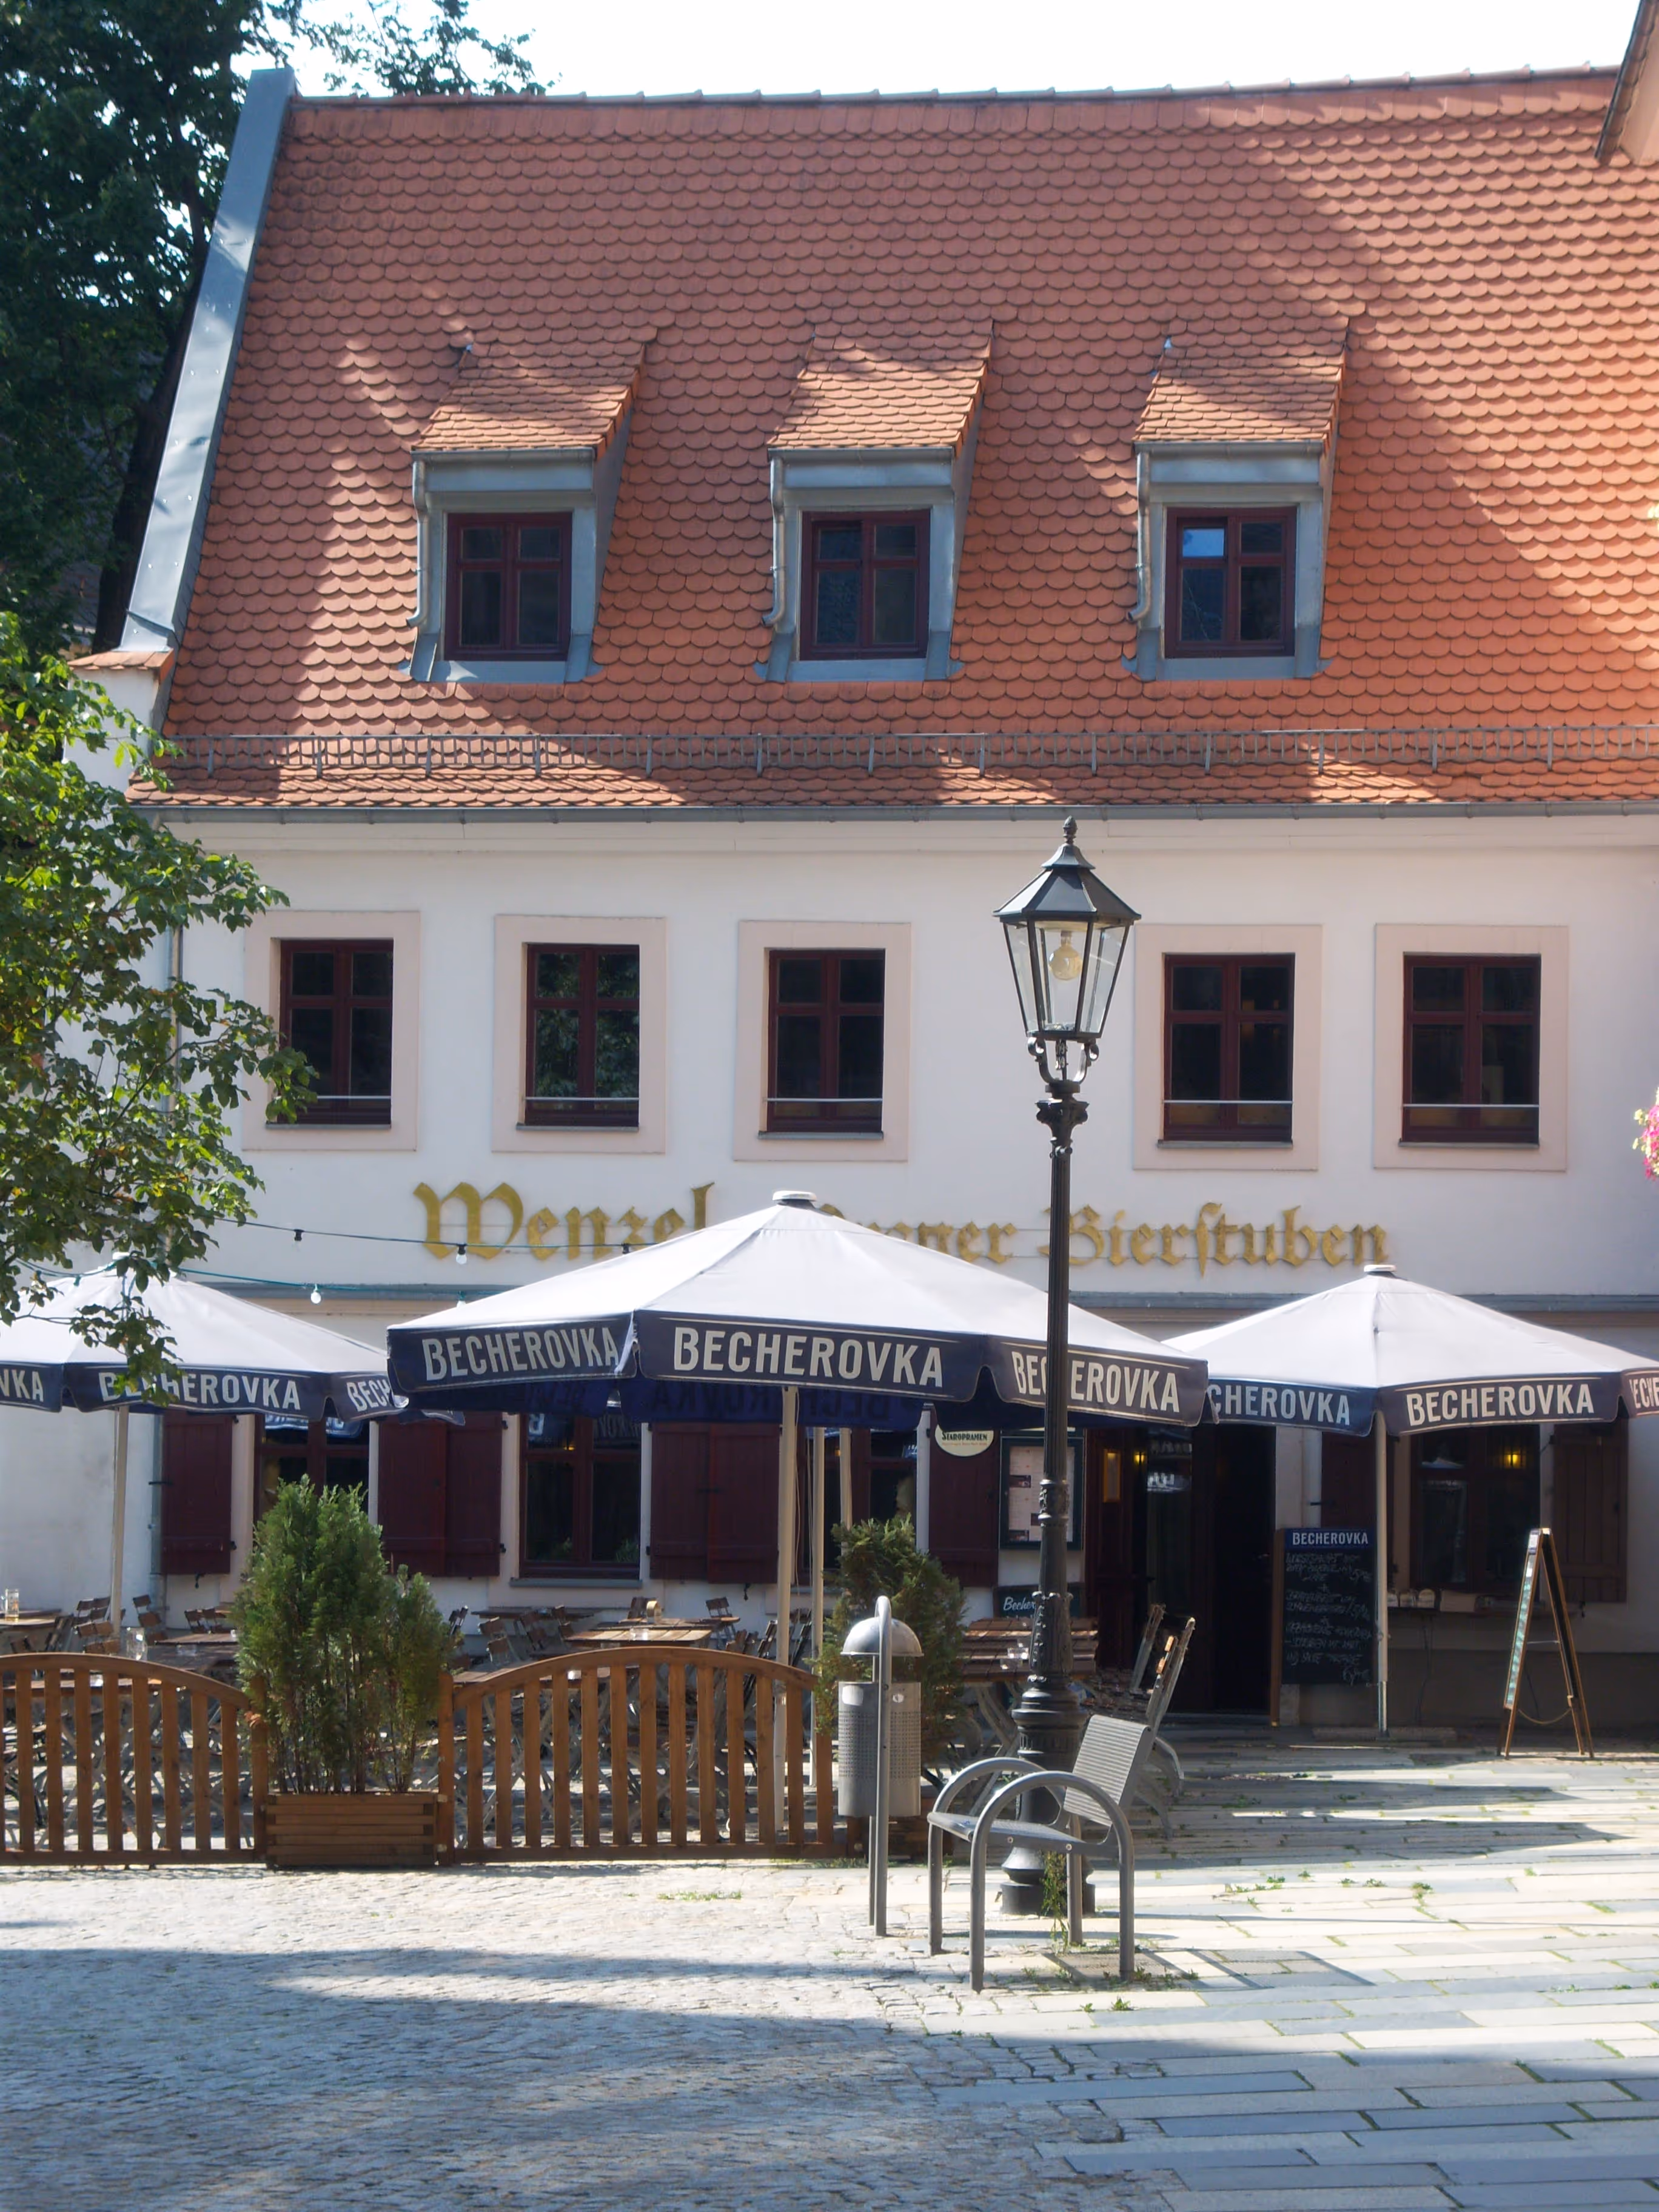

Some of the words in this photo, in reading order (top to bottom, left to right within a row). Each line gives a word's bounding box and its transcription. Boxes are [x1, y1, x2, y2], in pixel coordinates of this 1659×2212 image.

[413, 1182, 715, 1261] Wenzel
[422, 1326, 619, 1381] BECHEROVKA
[673, 1326, 943, 1388] BECHEROVKA
[98, 1372, 301, 1410] BHEROVKA
[1011, 1351, 1181, 1413] BEEROVKA
[1406, 1383, 1595, 1427] BECHEROVKA
[942, 1432, 988, 1441] STAROPRAMEN
[1292, 1532, 1369, 1546] BECHEROVKA
